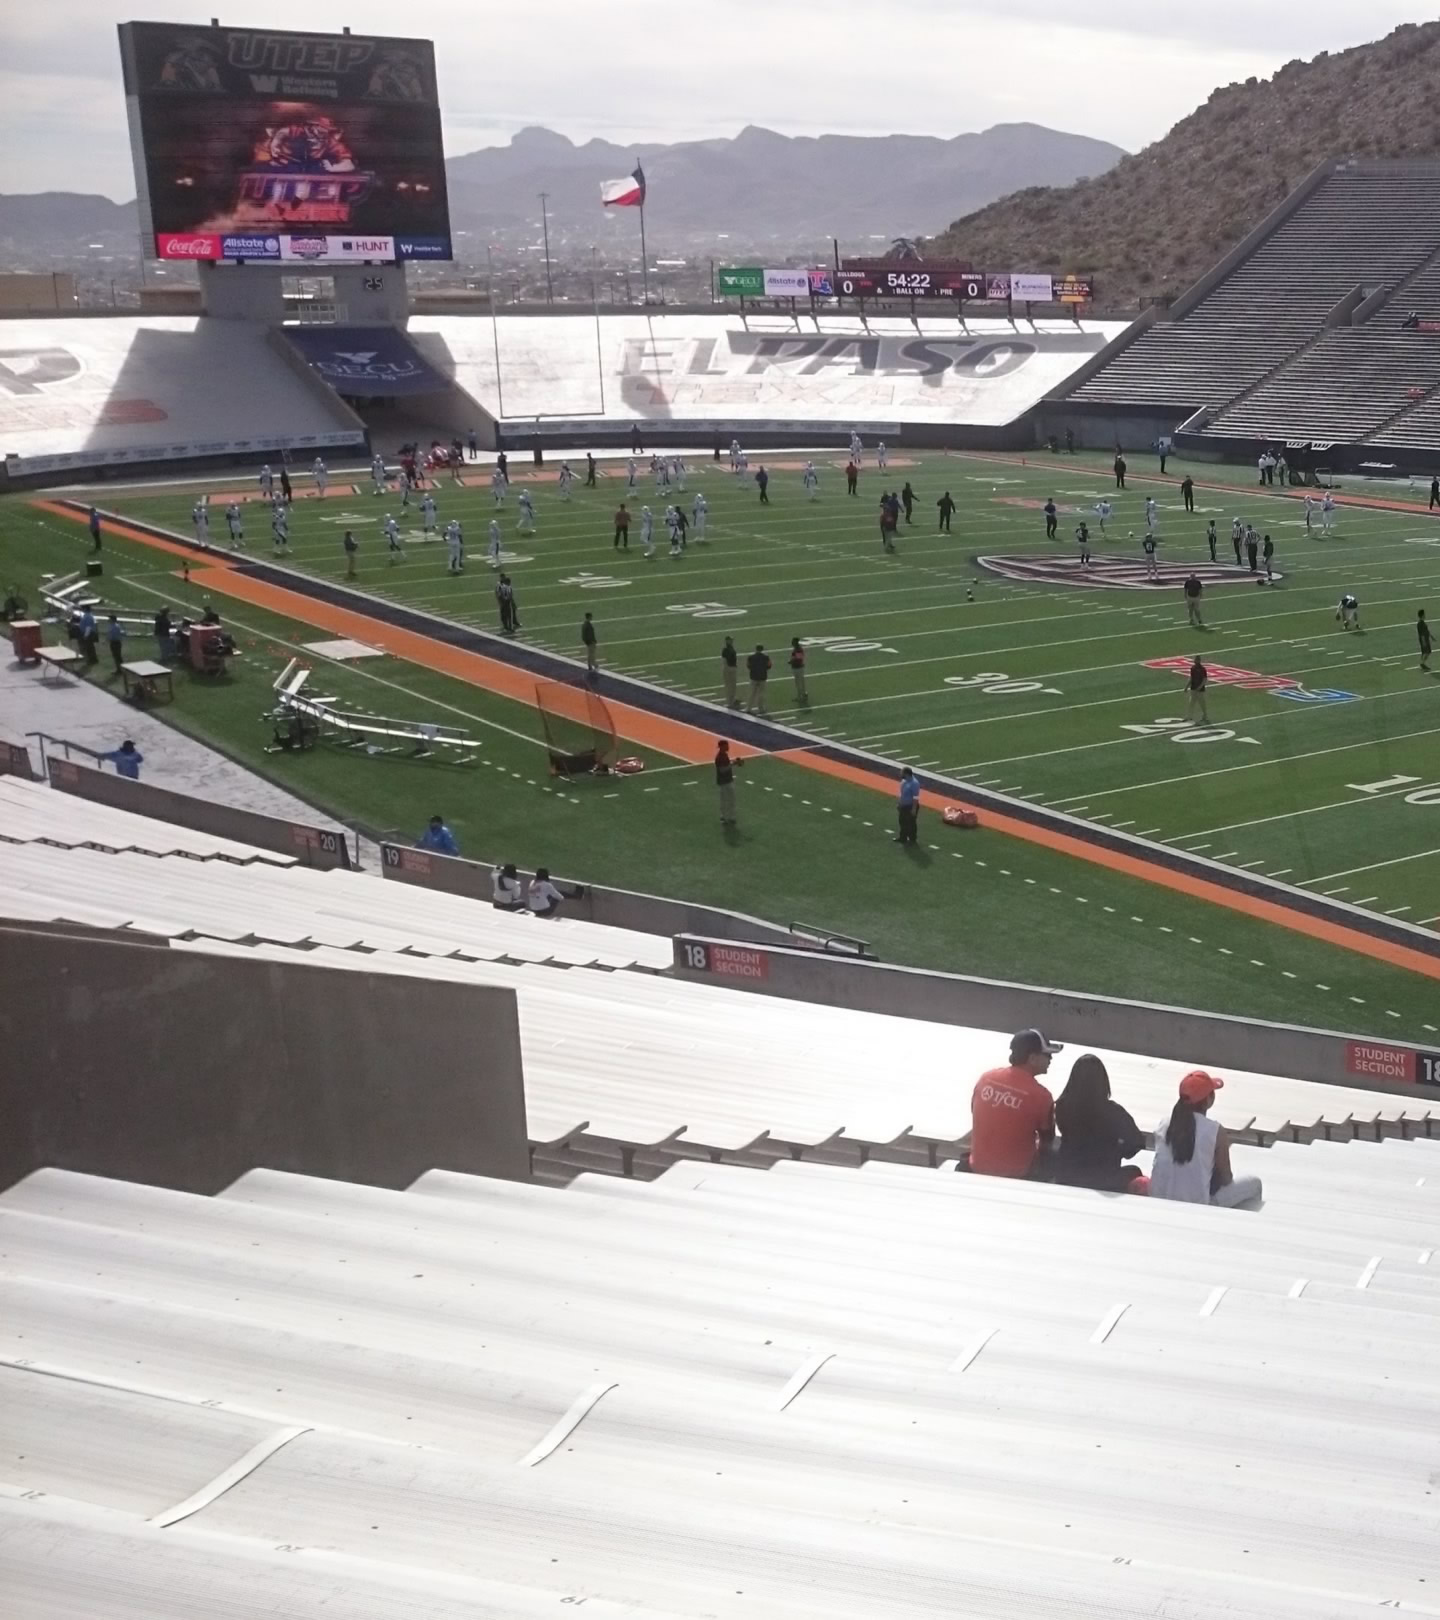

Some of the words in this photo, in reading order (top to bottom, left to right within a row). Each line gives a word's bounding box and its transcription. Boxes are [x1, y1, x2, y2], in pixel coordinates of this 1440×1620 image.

[227, 32, 376, 73] UTEP
[223, 238, 264, 249] Allstate
[355, 241, 390, 252] HUNT
[767, 276, 796, 285] Allstate
[843, 280, 854, 294] 0
[887, 273, 931, 288] 54:22
[896, 287, 913, 295] BALL
[914, 287, 925, 295] ON
[968, 282, 978, 297] 0
[614, 336, 729, 376] EL
[743, 335, 1040, 380] PASO
[665, 601, 748, 617] 50
[798, 635, 883, 652] 40
[943, 671, 1044, 694] 30
[1119, 716, 1237, 745] 20
[320, 833, 336, 852] 20
[385, 847, 400, 866] 19
[685, 945, 707, 968] 18
[714, 947, 761, 965] STUDENT
[715, 961, 761, 978] SECTION
[1354, 1047, 1406, 1064] STUDENT
[1355, 1060, 1405, 1077] SECTION
